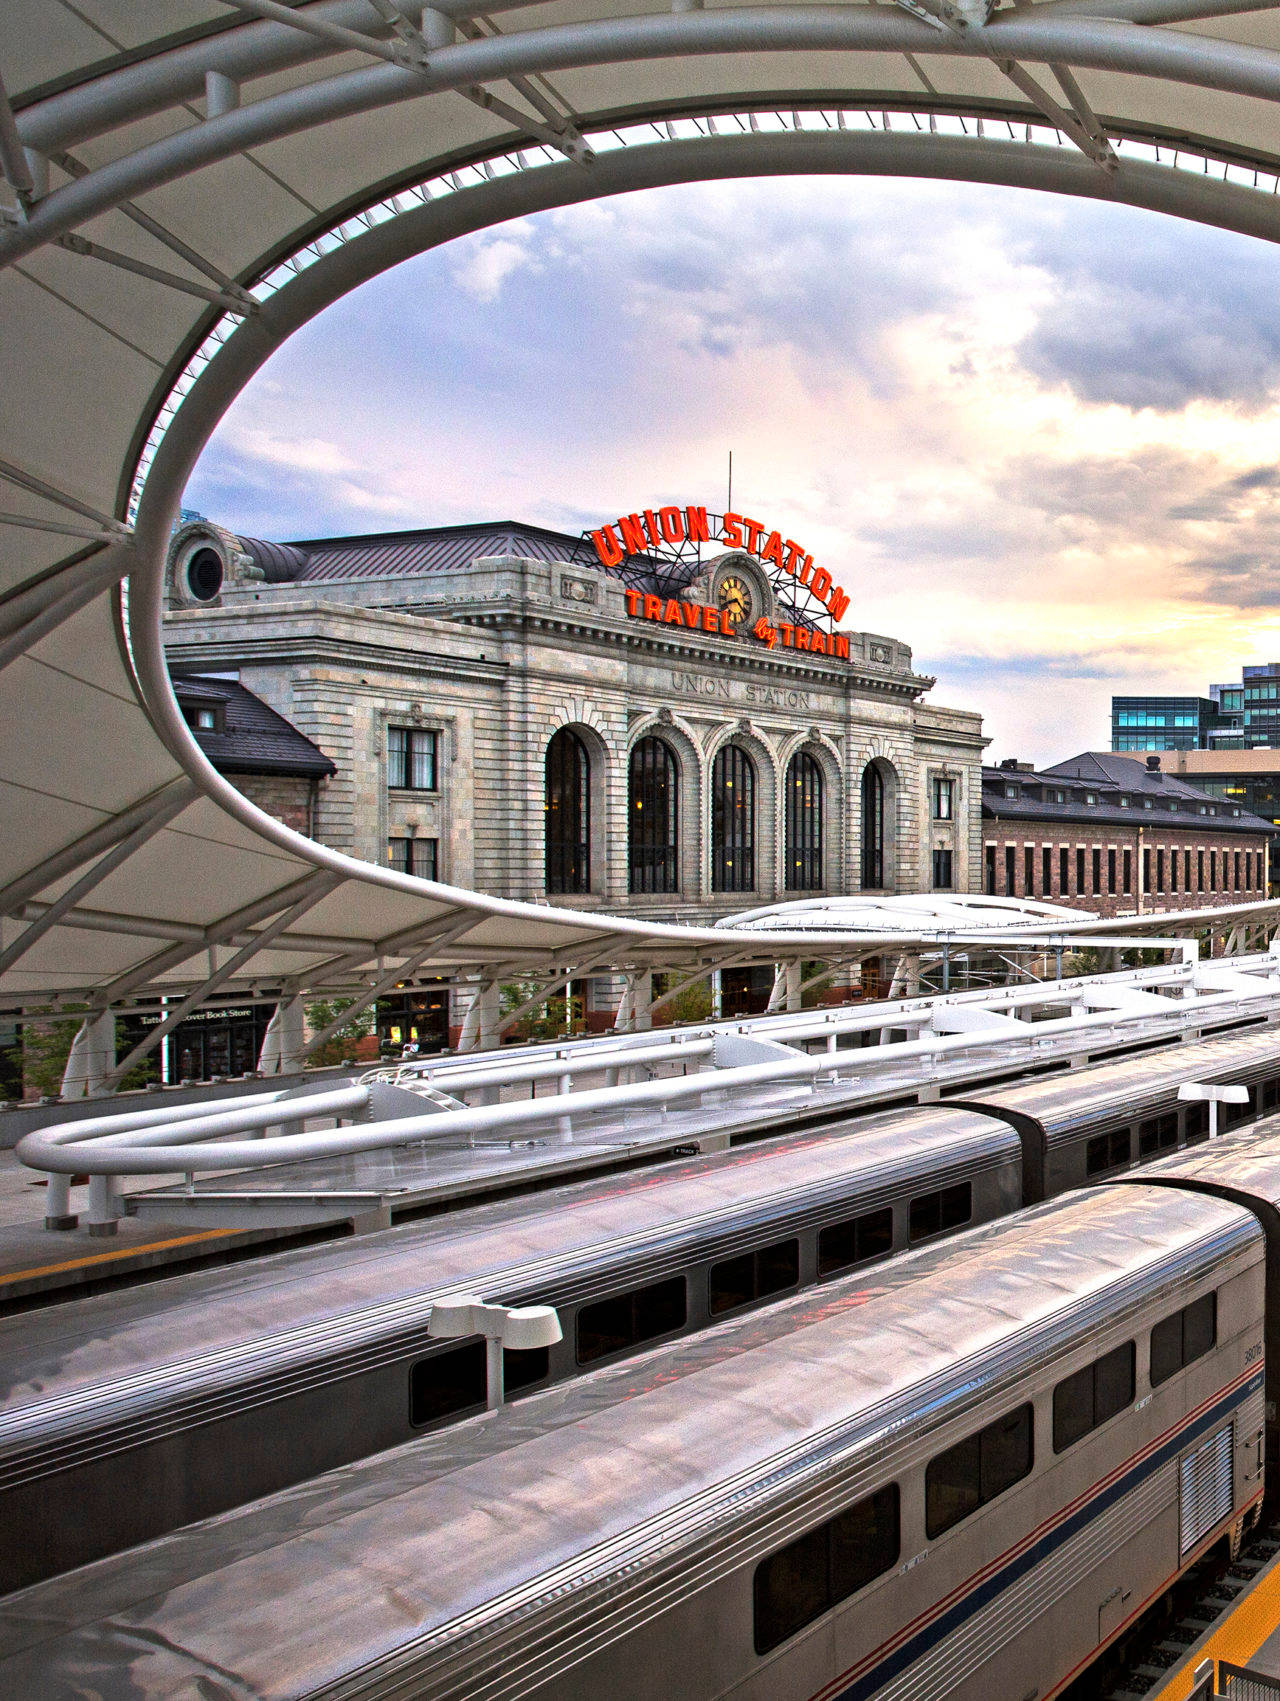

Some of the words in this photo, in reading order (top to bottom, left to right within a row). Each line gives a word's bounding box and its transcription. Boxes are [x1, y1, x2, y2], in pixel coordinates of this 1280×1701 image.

[591, 506, 710, 567] UNION
[723, 512, 851, 622] STATION
[625, 589, 736, 636] TRAVEL
[753, 617, 778, 650] by
[779, 622, 850, 659] TRAIN
[671, 671, 730, 698] UNION
[746, 684, 810, 709] STATION
[183, 1012, 206, 1021] over
[206, 1010, 228, 1020] Book
[228, 1009, 252, 1018] Store
